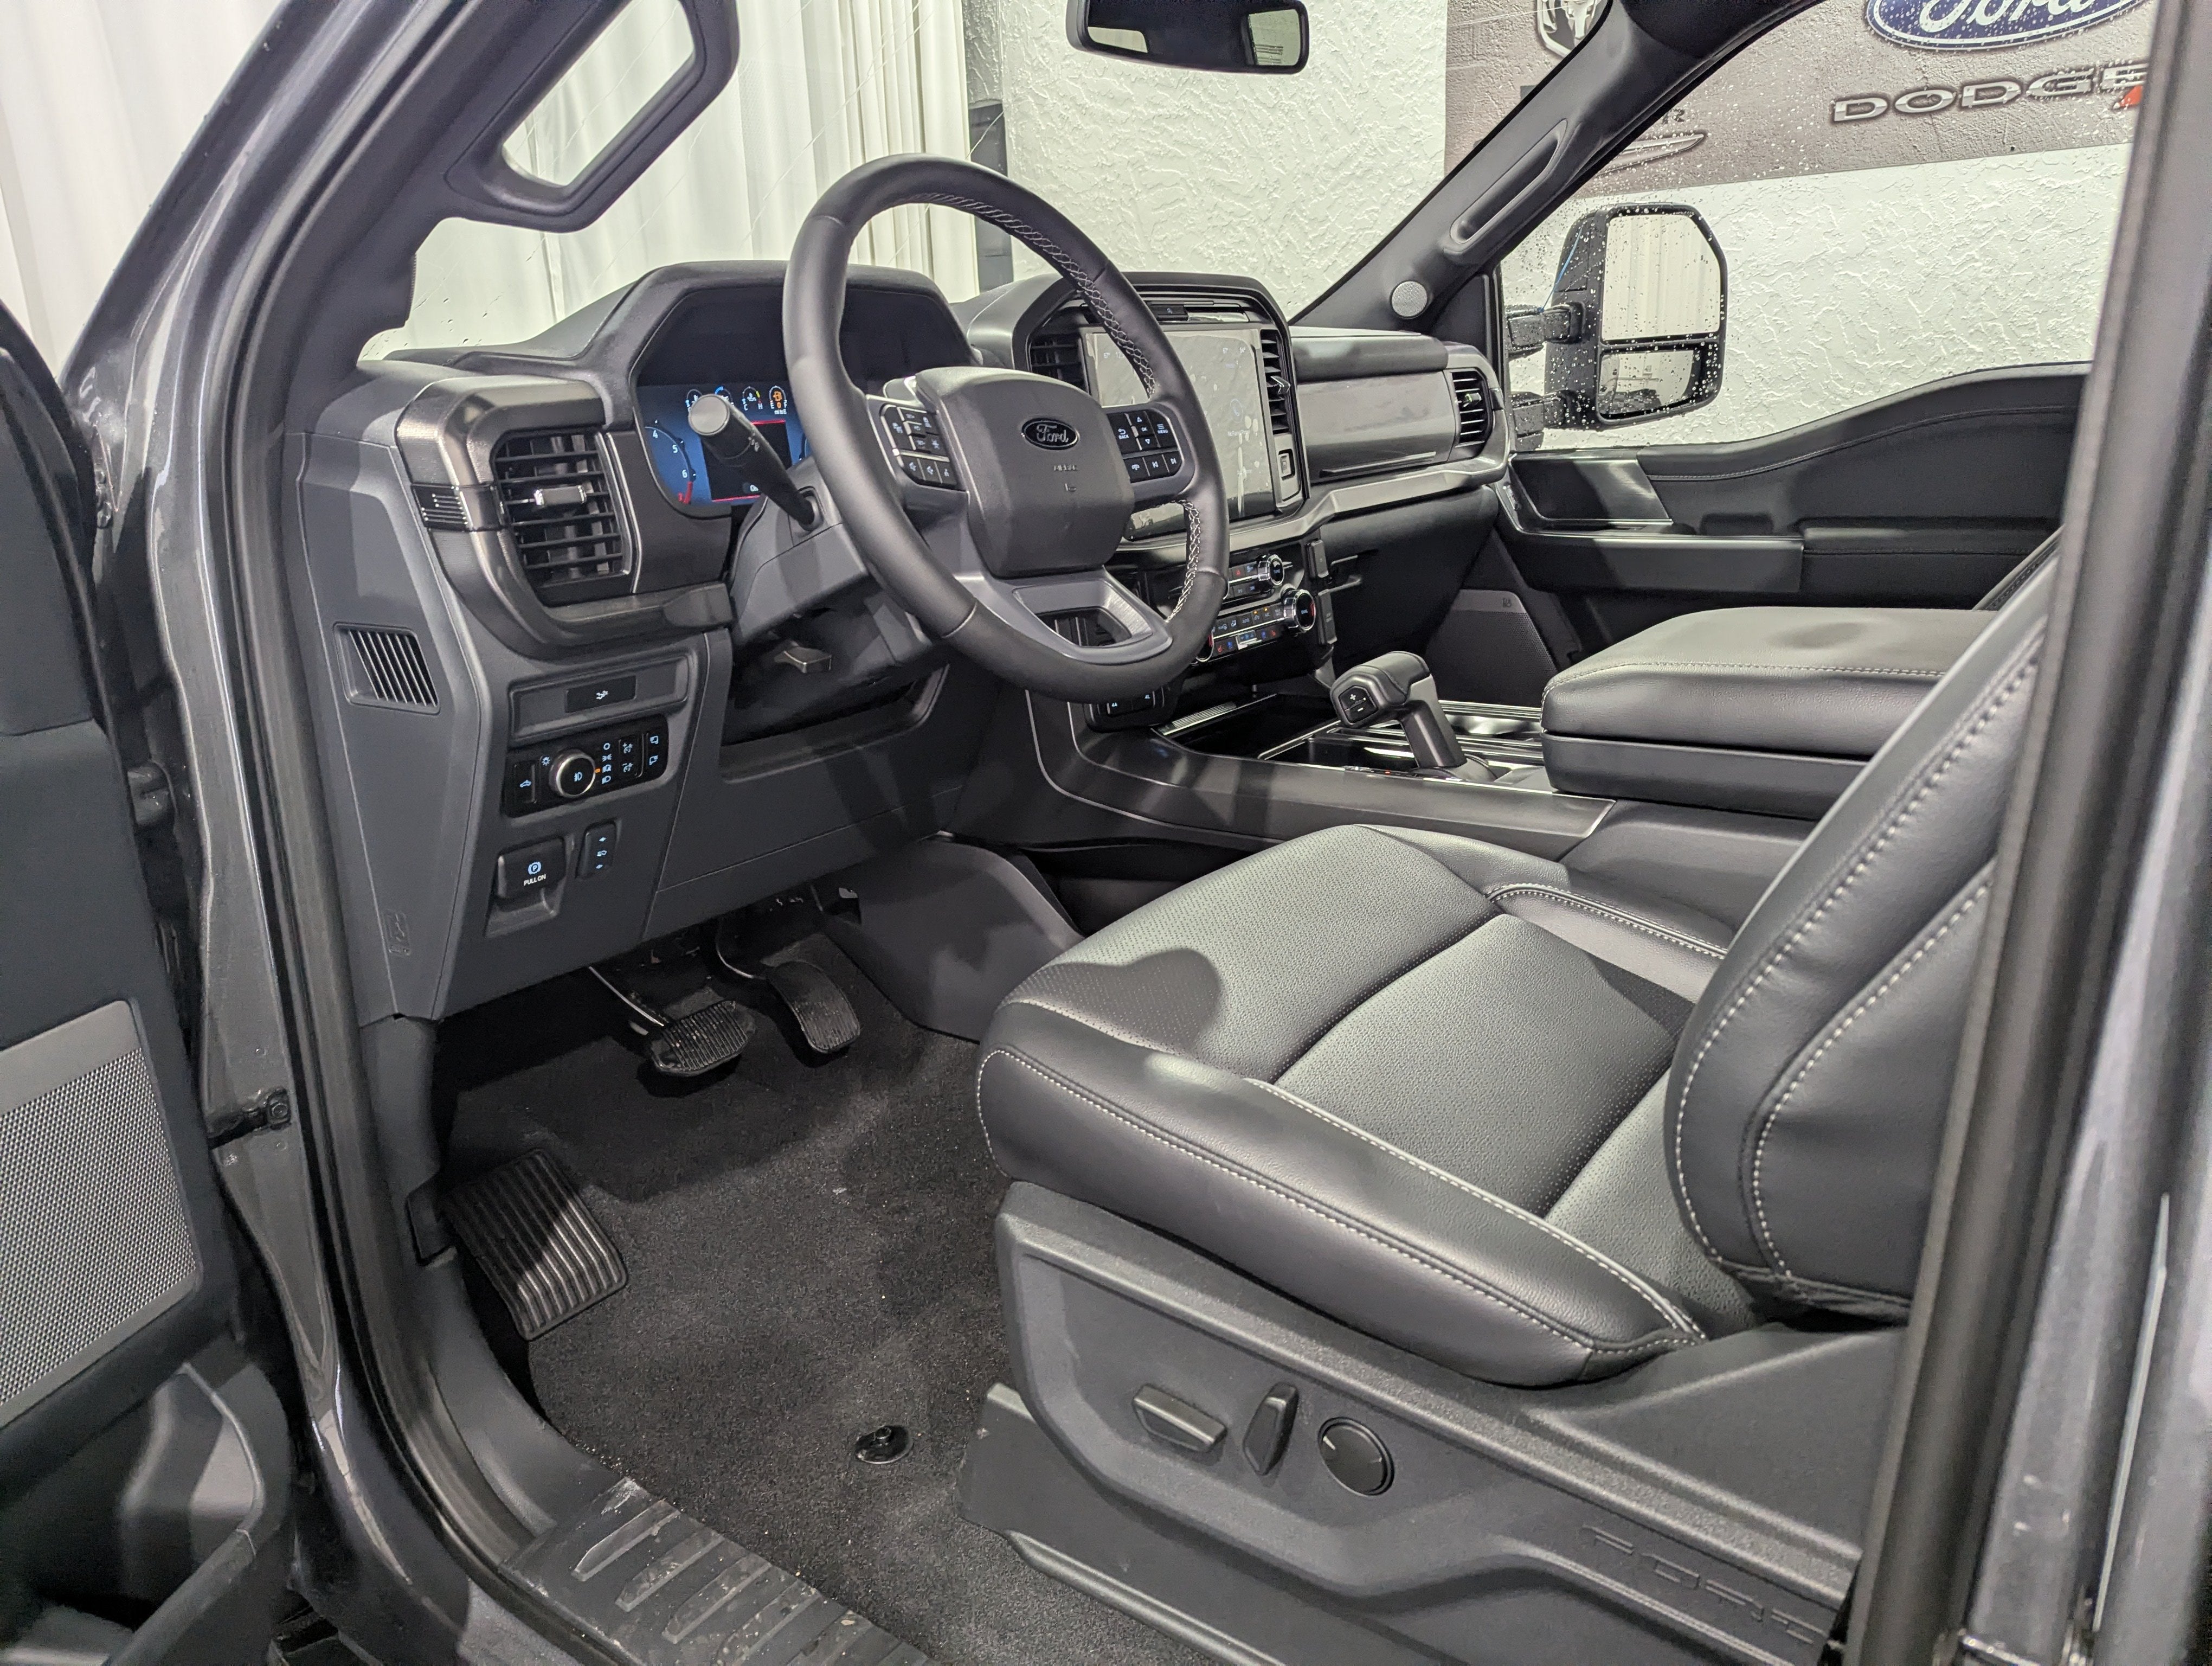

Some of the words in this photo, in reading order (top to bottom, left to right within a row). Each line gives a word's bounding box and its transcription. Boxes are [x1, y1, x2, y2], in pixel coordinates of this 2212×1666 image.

[1834, 63, 2148, 123] DODGE
[652, 430, 658, 439] 4
[1036, 424, 1069, 443] Ford
[672, 445, 678, 453] 5
[681, 469, 688, 478] 6
[523, 877, 537, 886] PULL
